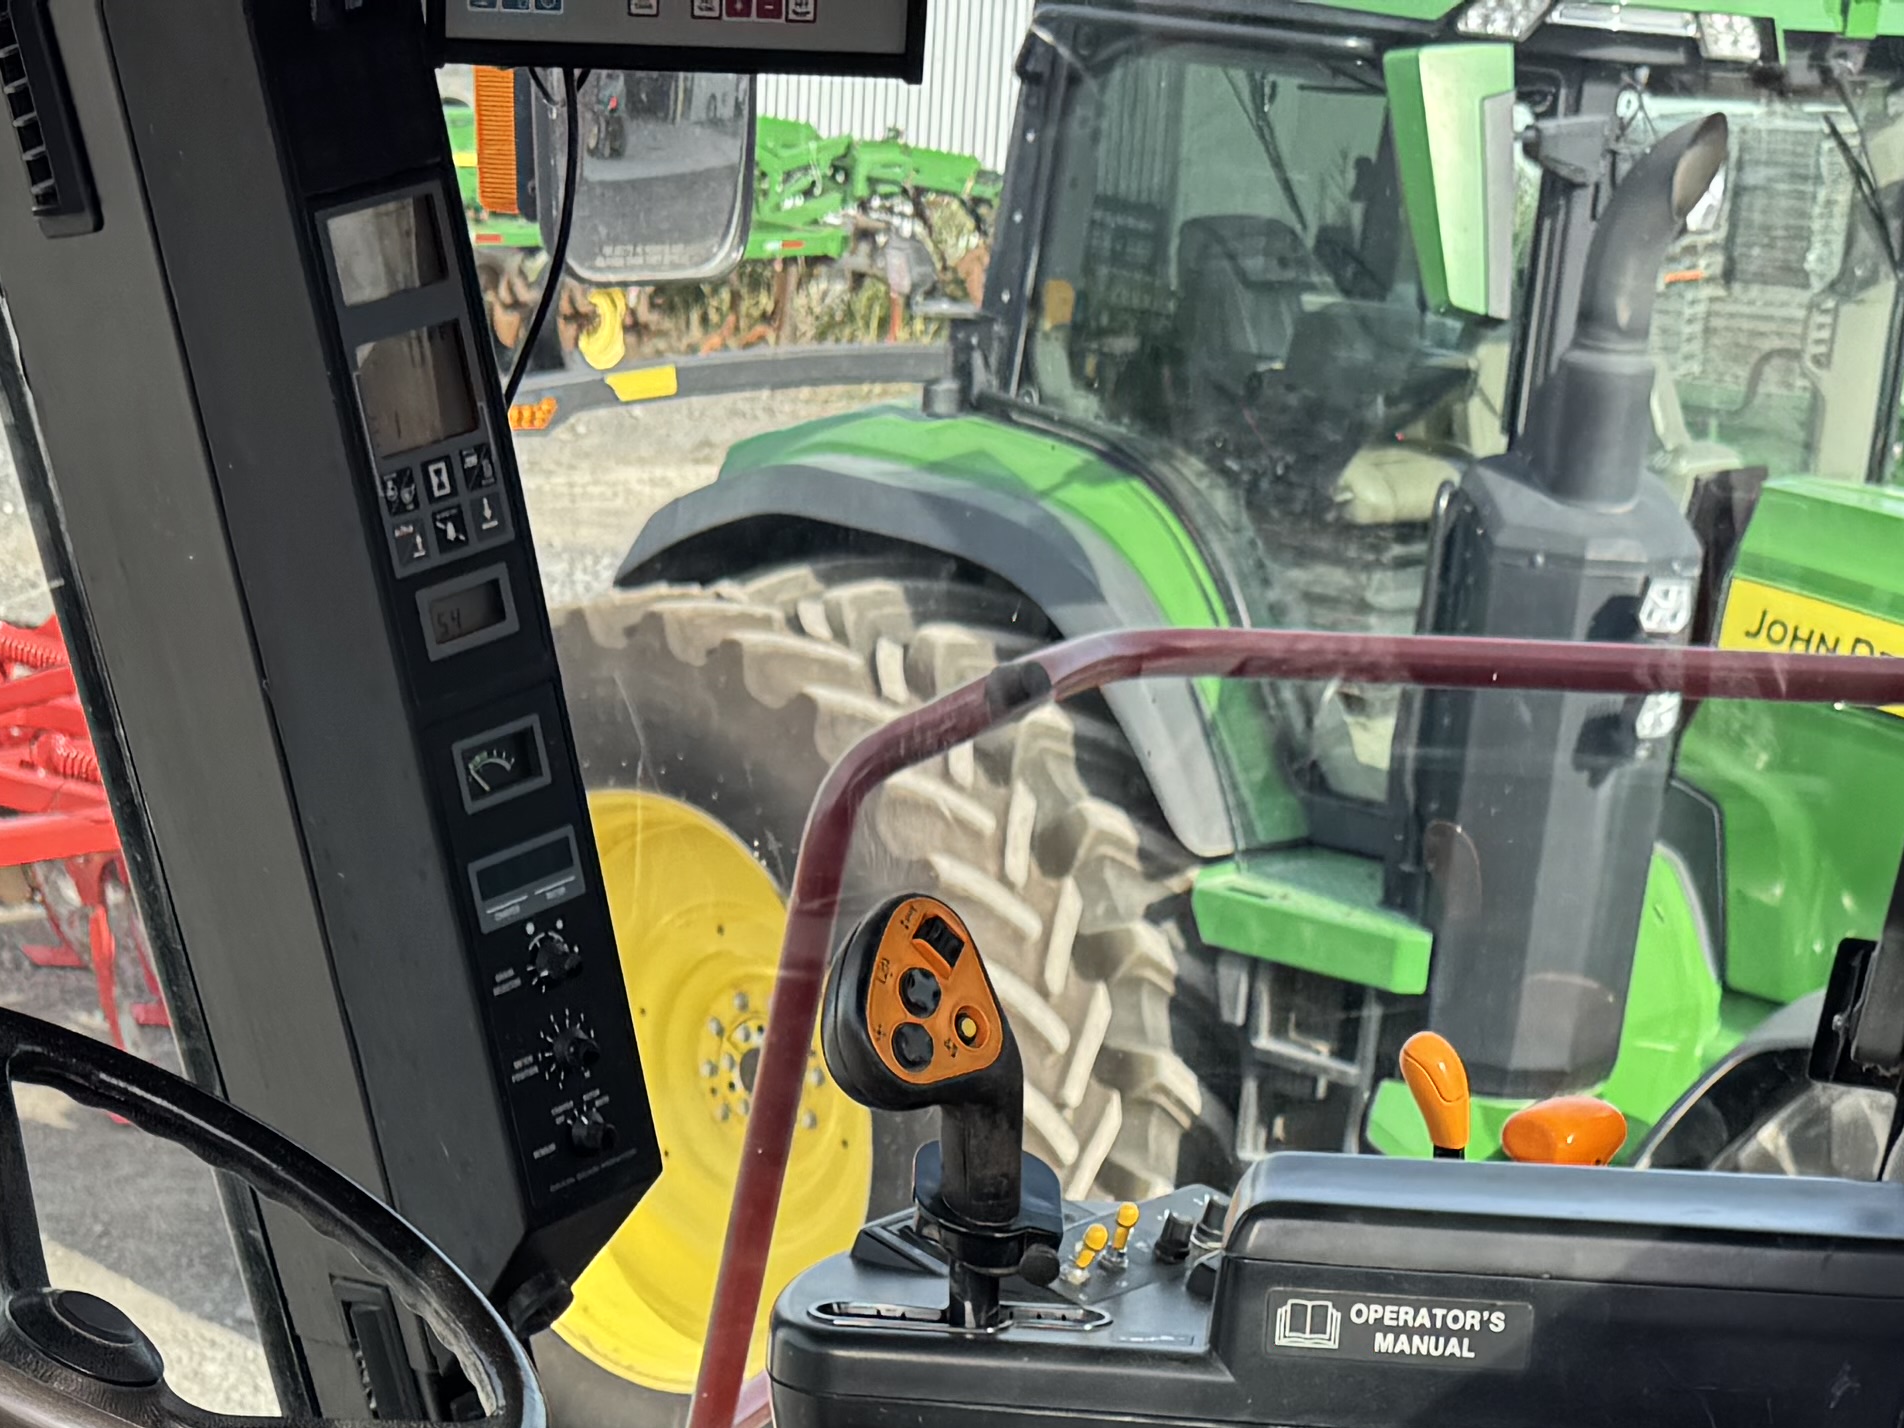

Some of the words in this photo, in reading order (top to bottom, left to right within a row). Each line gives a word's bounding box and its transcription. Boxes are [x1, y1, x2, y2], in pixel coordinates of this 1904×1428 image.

[1745, 609, 1840, 655] JOHN
[1350, 1303, 1506, 1333] OPERATOR'S
[1374, 1332, 1476, 1359] MANUAL
